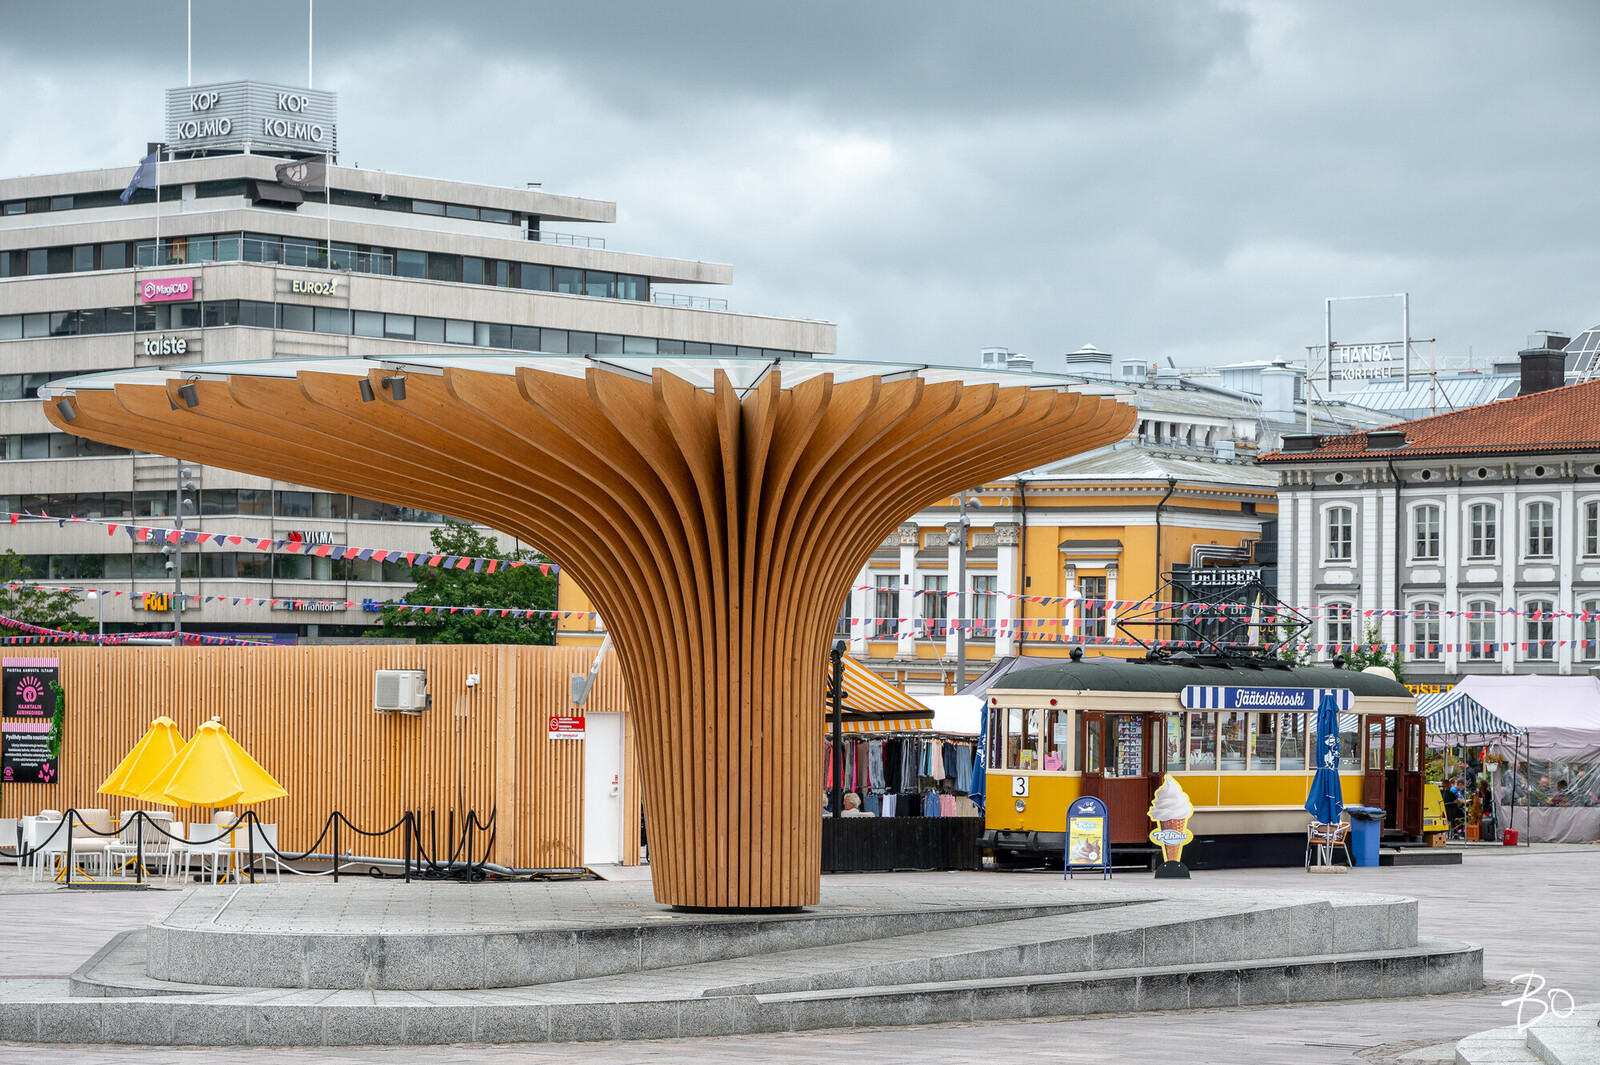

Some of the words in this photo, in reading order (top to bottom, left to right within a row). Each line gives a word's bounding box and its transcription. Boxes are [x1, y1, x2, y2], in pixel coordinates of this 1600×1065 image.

[190, 92, 219, 111] KOP
[278, 92, 309, 112] KOP
[177, 117, 231, 140] KOLMIO
[264, 118, 323, 142] KOLMIO
[156, 282, 188, 297] MagiCAD
[291, 278, 338, 296] EURO24
[143, 334, 187, 355] taiste
[1340, 345, 1392, 363] HANSA
[1341, 367, 1391, 380] KORTTELI
[305, 531, 334, 544] VISMA
[1235, 688, 1306, 708] Jäätelökioski
[1015, 777, 1026, 796] 3
